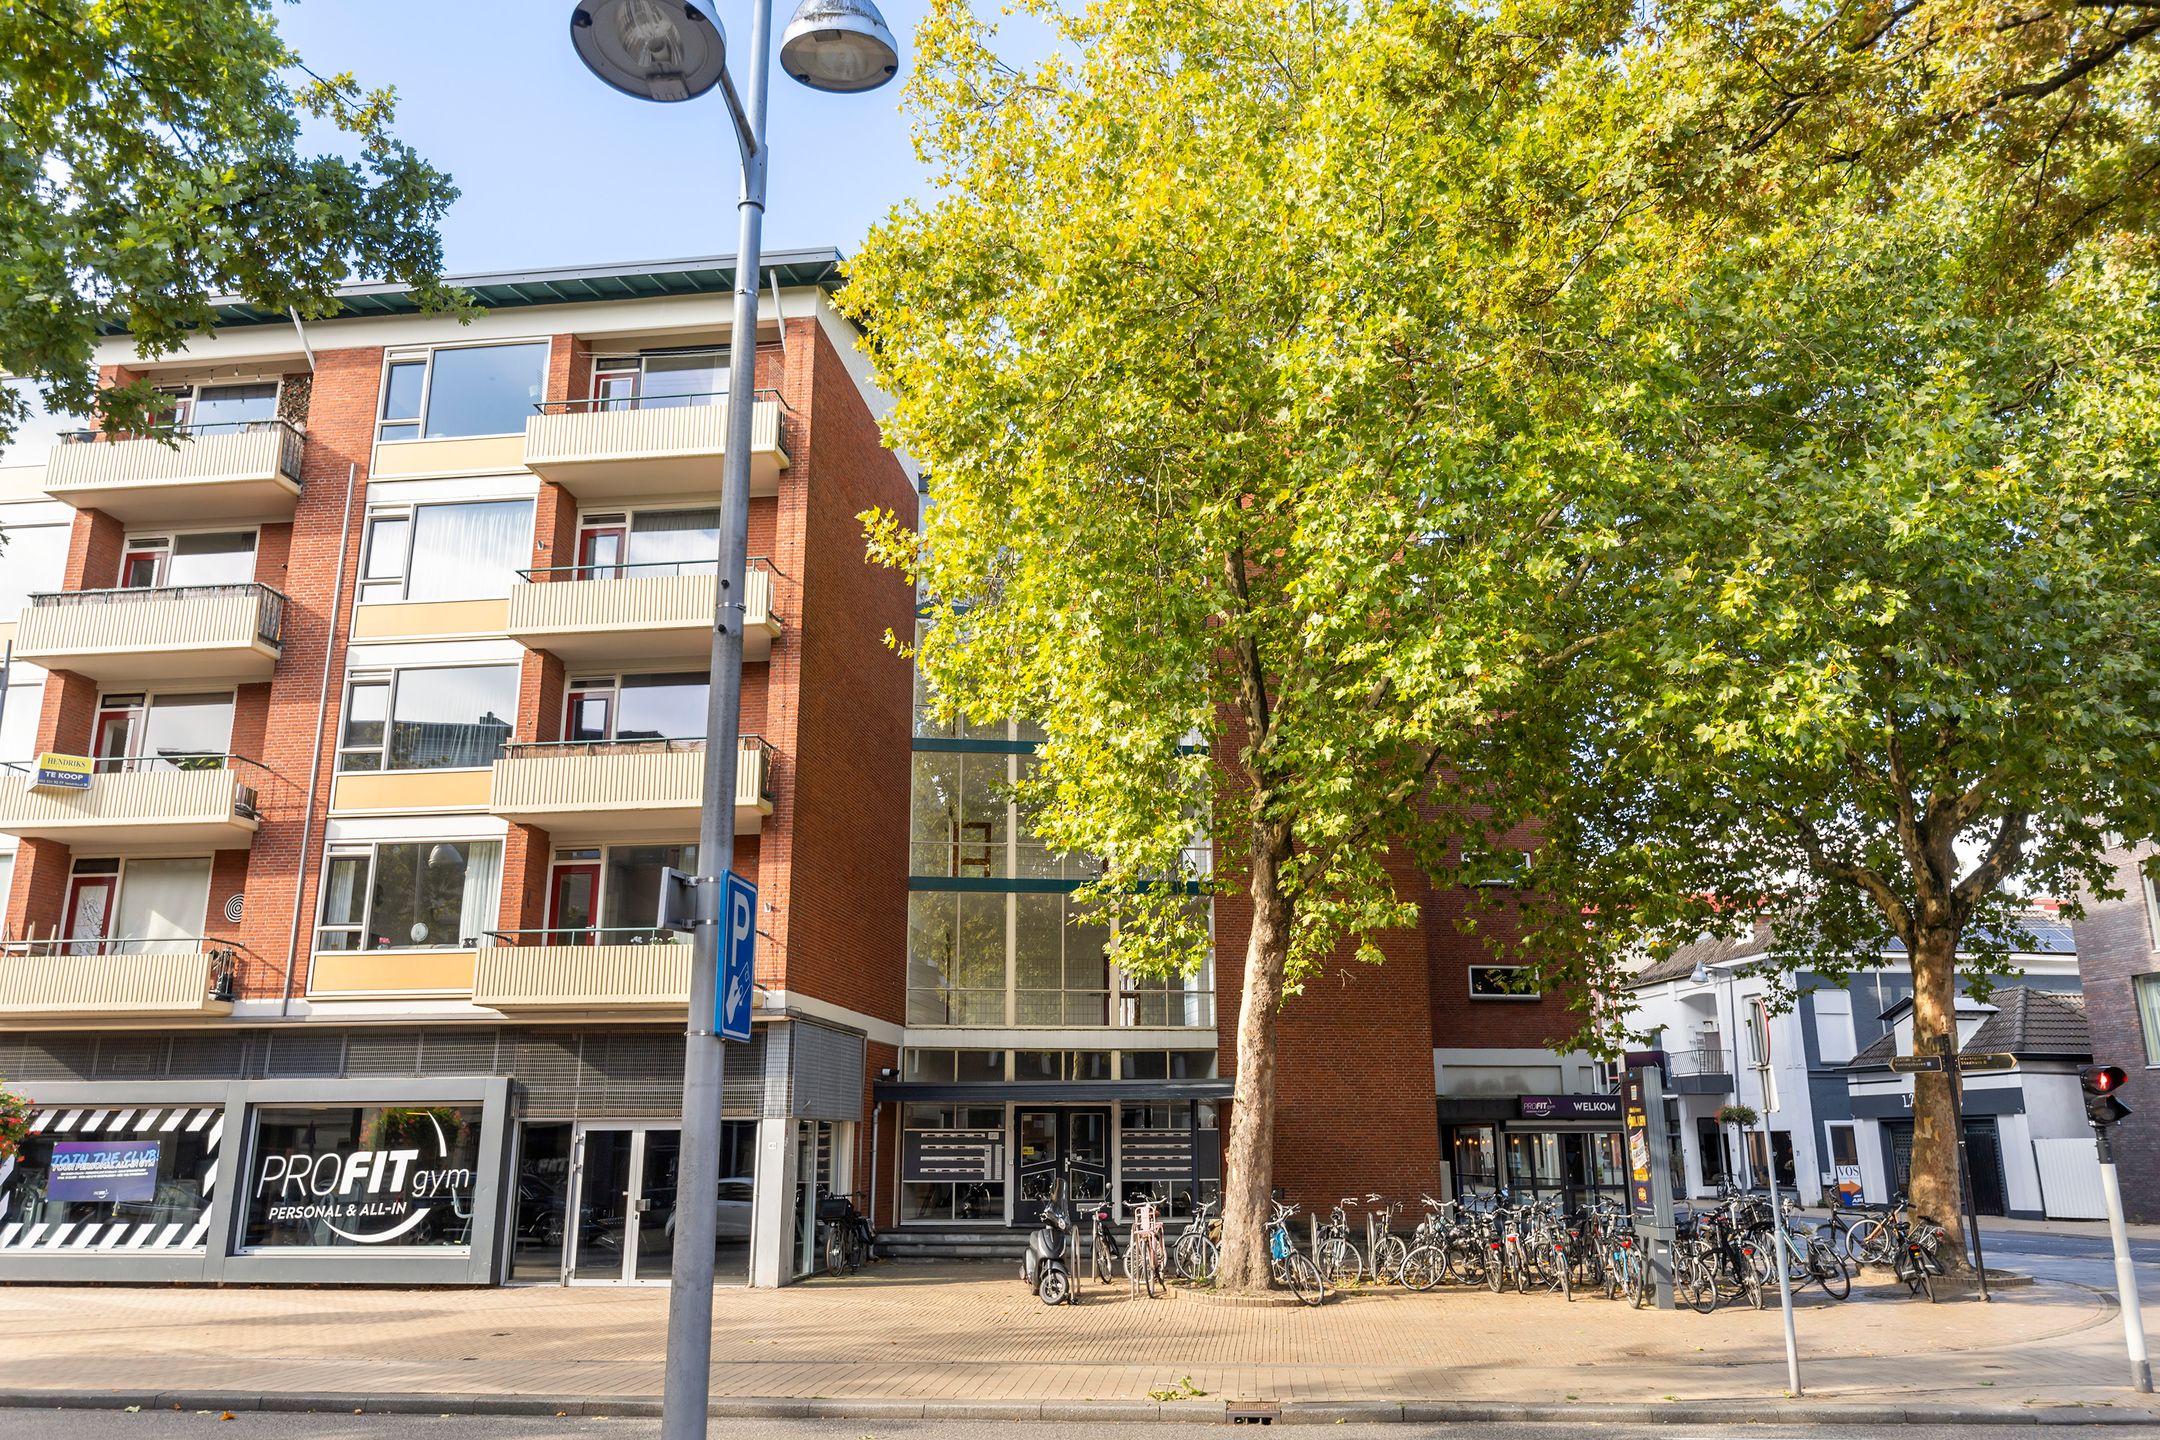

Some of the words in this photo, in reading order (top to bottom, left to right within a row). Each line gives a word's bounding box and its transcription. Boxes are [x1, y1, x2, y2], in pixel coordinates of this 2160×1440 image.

[47, 757, 86, 768] HENDRIKS
[58, 773, 83, 781] KOOP
[732, 890, 750, 967] P
[1523, 1102, 1547, 1110] PROFIT
[1573, 1102, 1616, 1112] WELKOM
[52, 1153, 89, 1167] JOIN
[93, 1151, 122, 1164] THE
[124, 1148, 160, 1162] CLUB!
[256, 1149, 419, 1199] PROFIT
[411, 1168, 470, 1198] gym
[1838, 1166, 1860, 1177] VOS
[268, 1204, 343, 1220] PERSONAL
[346, 1204, 356, 1216] &
[359, 1201, 407, 1216] ALL-IN
